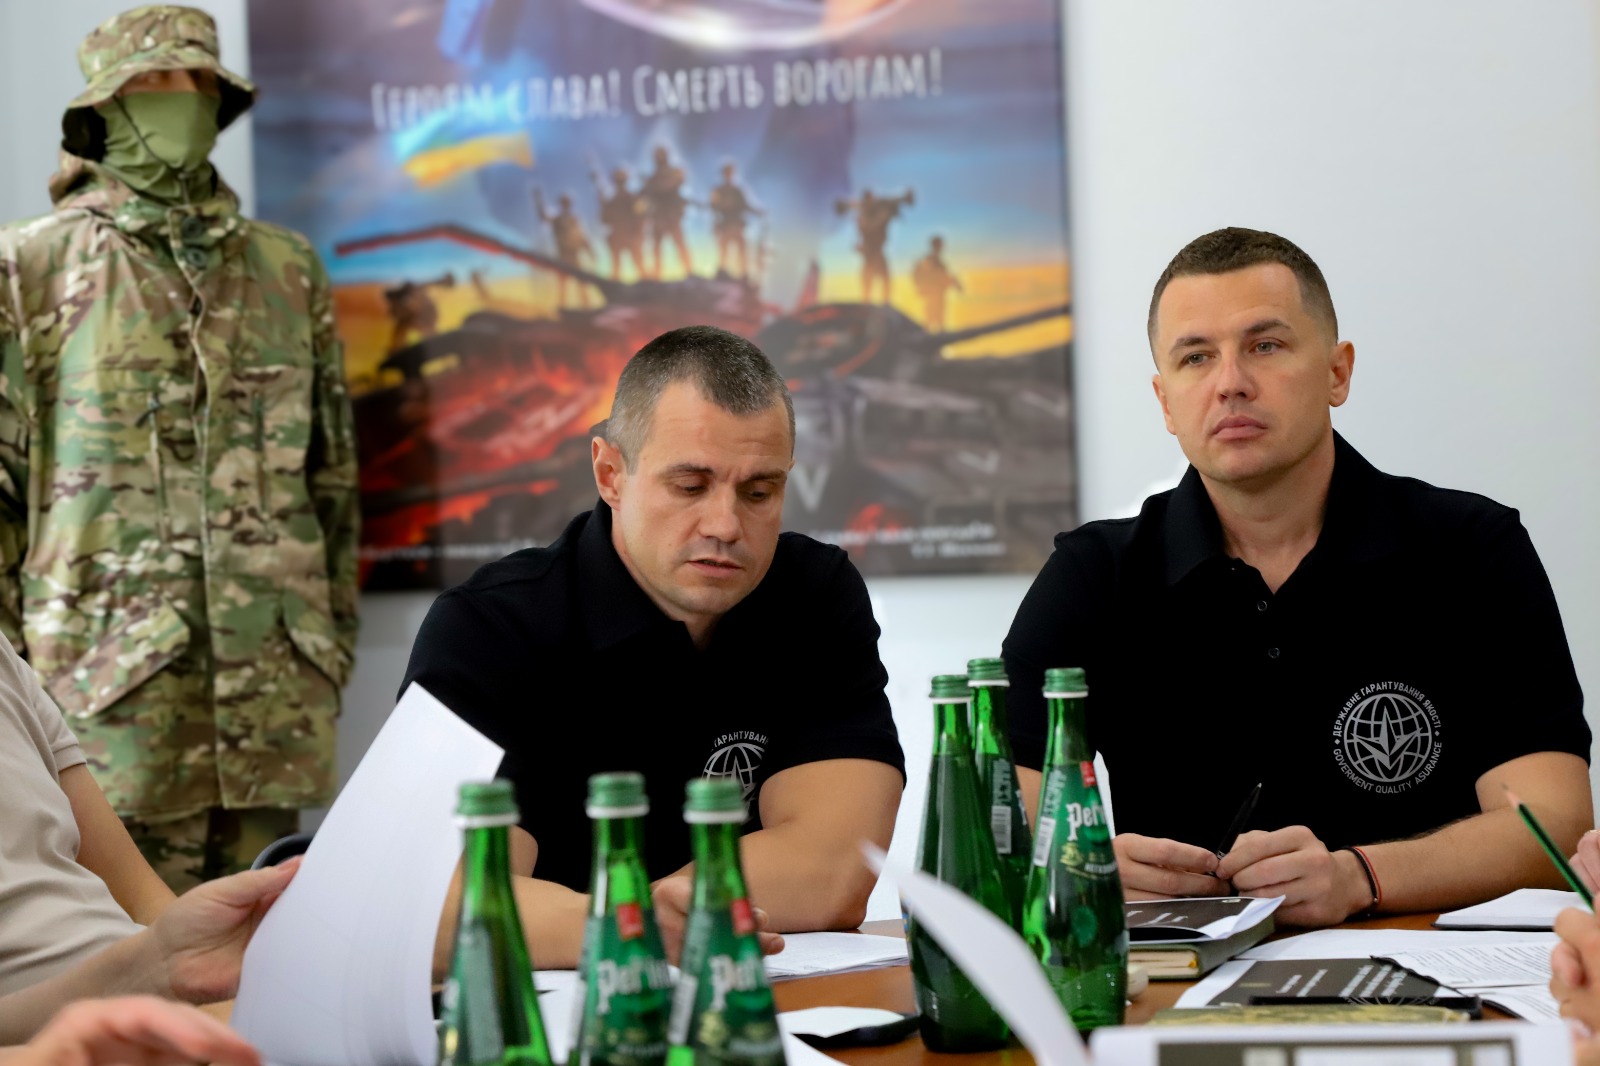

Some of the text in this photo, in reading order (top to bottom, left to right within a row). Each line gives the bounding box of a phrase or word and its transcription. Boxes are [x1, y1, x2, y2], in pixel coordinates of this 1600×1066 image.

[1332, 681, 1442, 737] ДЕРЖАВНЕ ГАРАНТУВАННЯ ЯКОСТІ
[1333, 741, 1443, 794] GOVERMENT QUALITY ASURANCE
